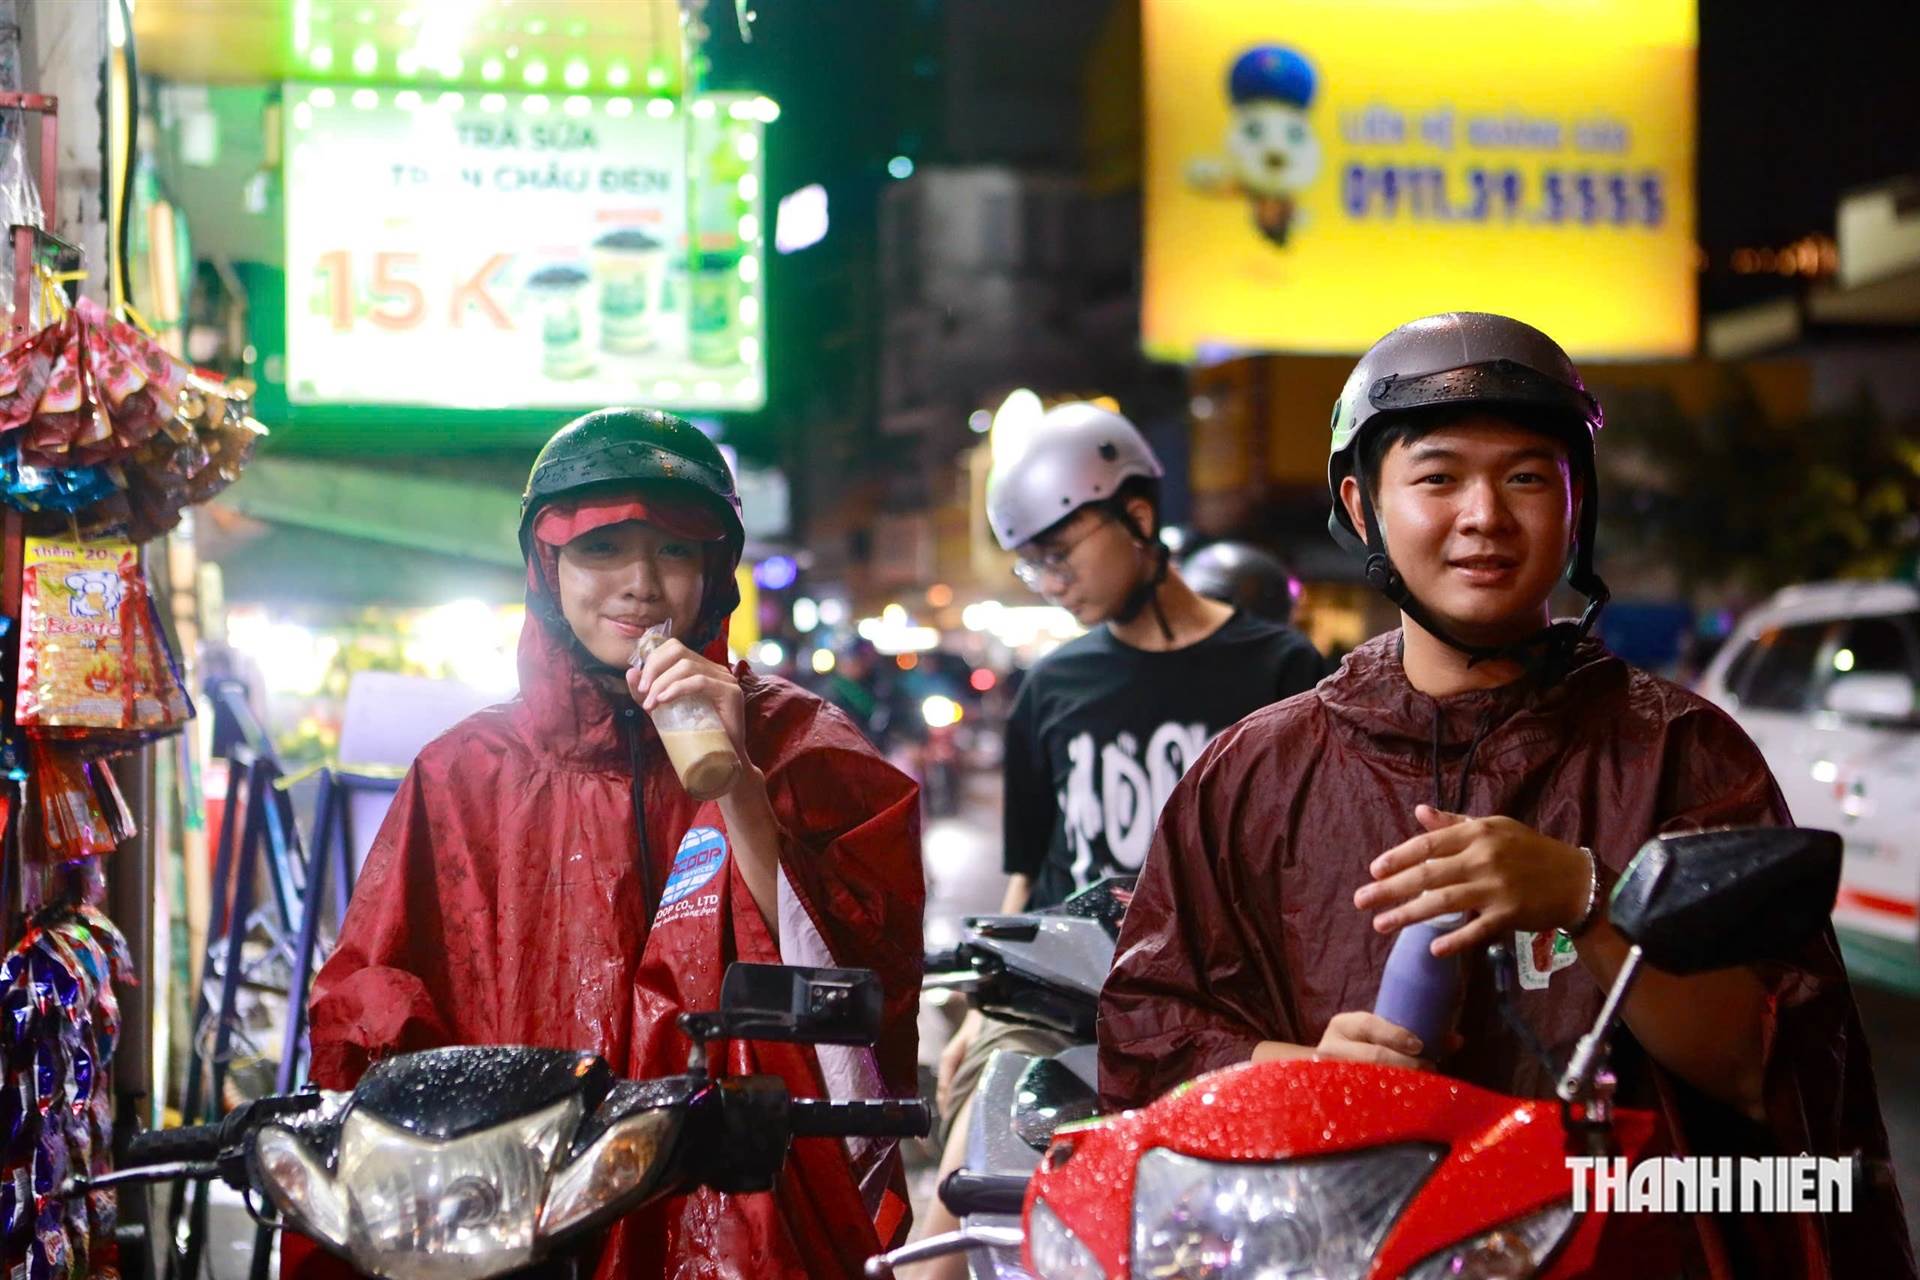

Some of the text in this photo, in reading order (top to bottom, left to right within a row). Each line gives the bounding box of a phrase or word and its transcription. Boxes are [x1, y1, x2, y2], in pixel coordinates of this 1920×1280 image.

[455, 118, 518, 150] TRÀ
[494, 157, 589, 193] CHÂU
[599, 164, 670, 193] ĐEN
[697, 894, 718, 907] LTD
